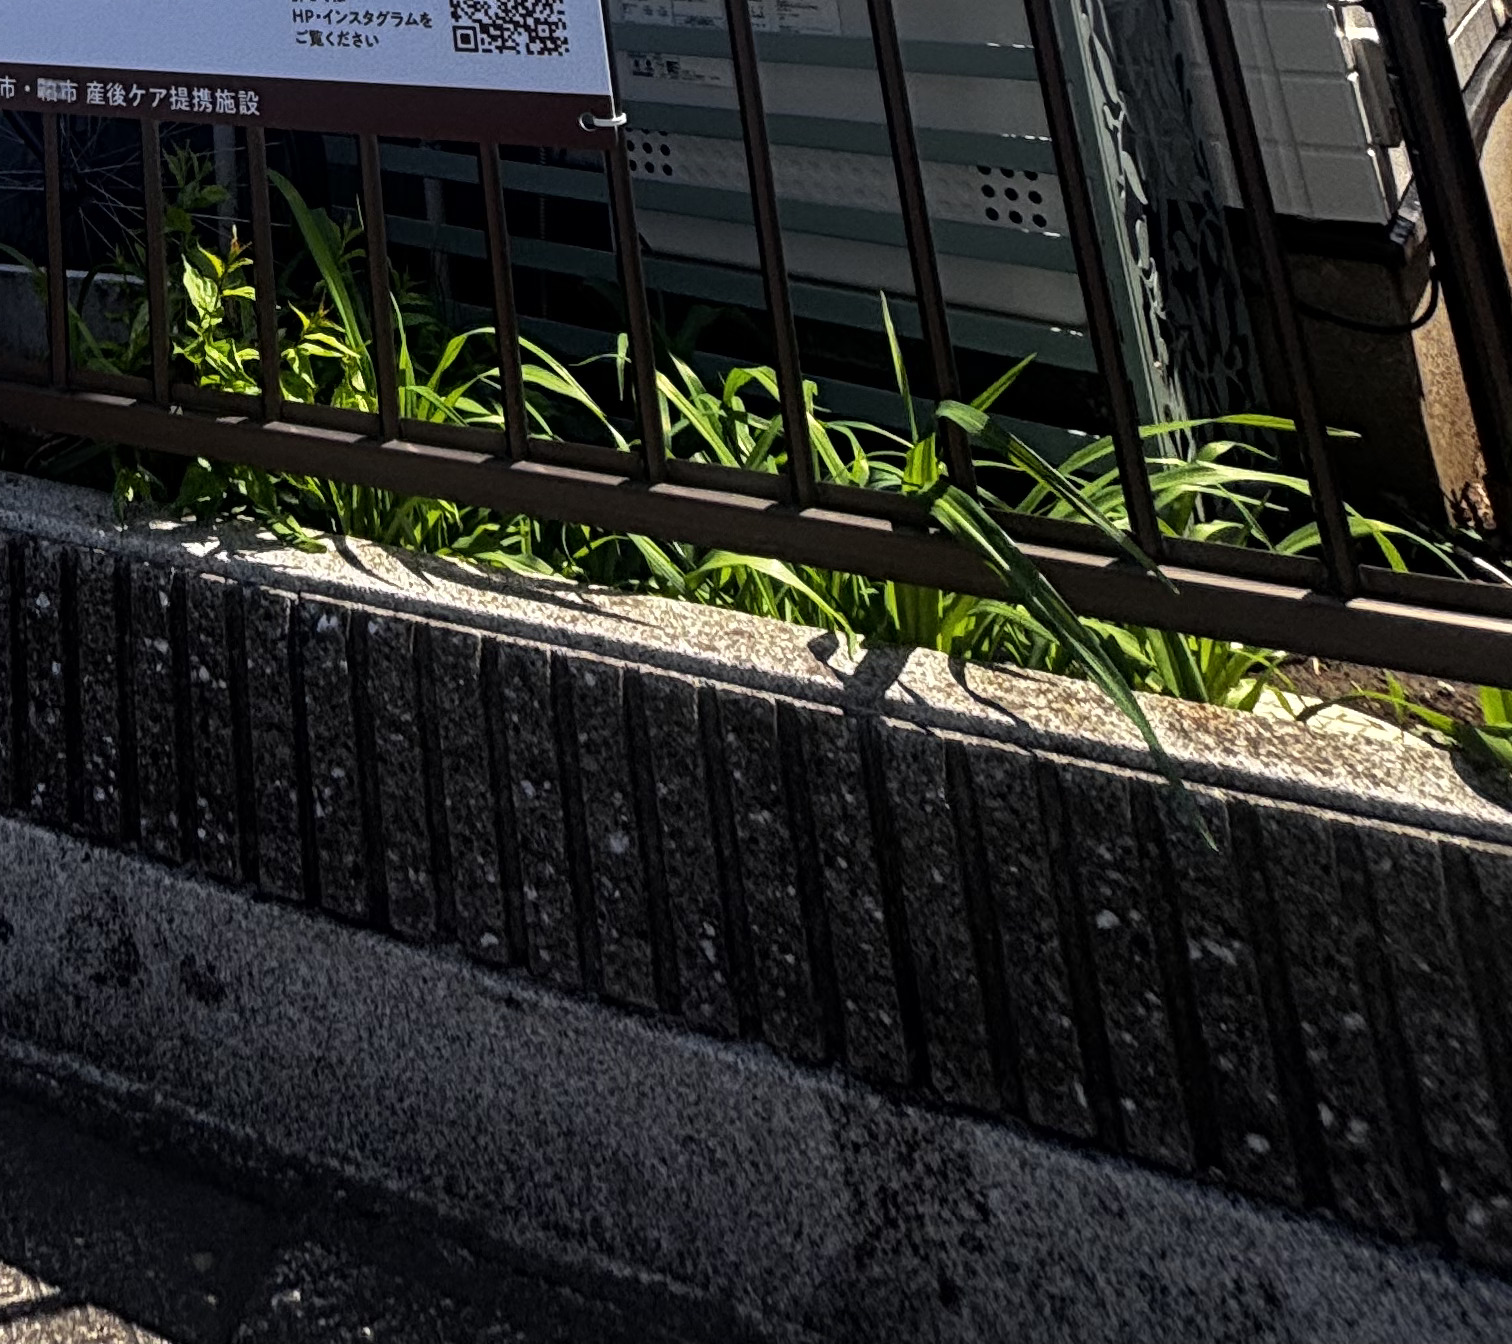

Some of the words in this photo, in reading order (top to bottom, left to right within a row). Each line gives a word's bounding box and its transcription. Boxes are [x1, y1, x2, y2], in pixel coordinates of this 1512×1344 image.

[292, 8, 433, 29] HP・インスタグラムを
[295, 29, 380, 49] ご覧ください
[86, 81, 261, 116] 産後ケア提携施設
